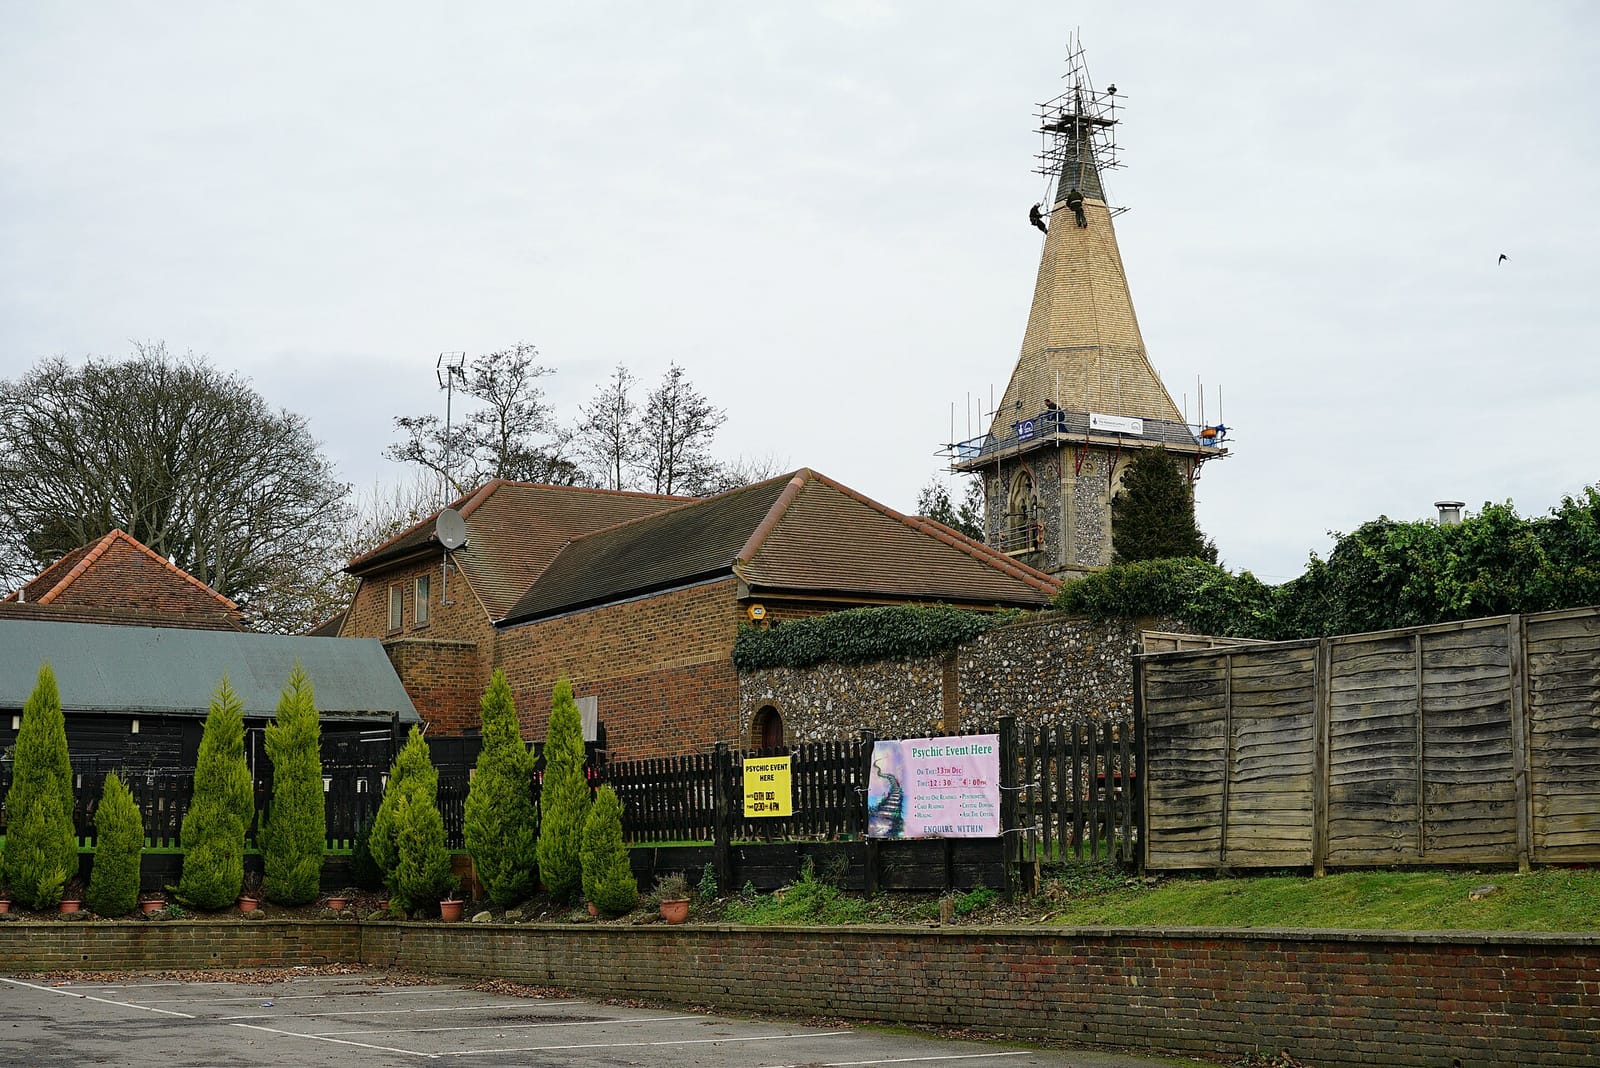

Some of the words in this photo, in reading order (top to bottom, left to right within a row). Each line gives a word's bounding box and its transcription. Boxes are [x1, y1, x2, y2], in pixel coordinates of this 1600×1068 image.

[912, 746, 943, 759] Psychic
[946, 746, 968, 756] Event
[971, 744, 992, 755] Here
[760, 774, 774, 782] HERE
[766, 791, 775, 800] DEC
[924, 825, 953, 834] ENQUIRE
[958, 825, 983, 833] WITHIN
